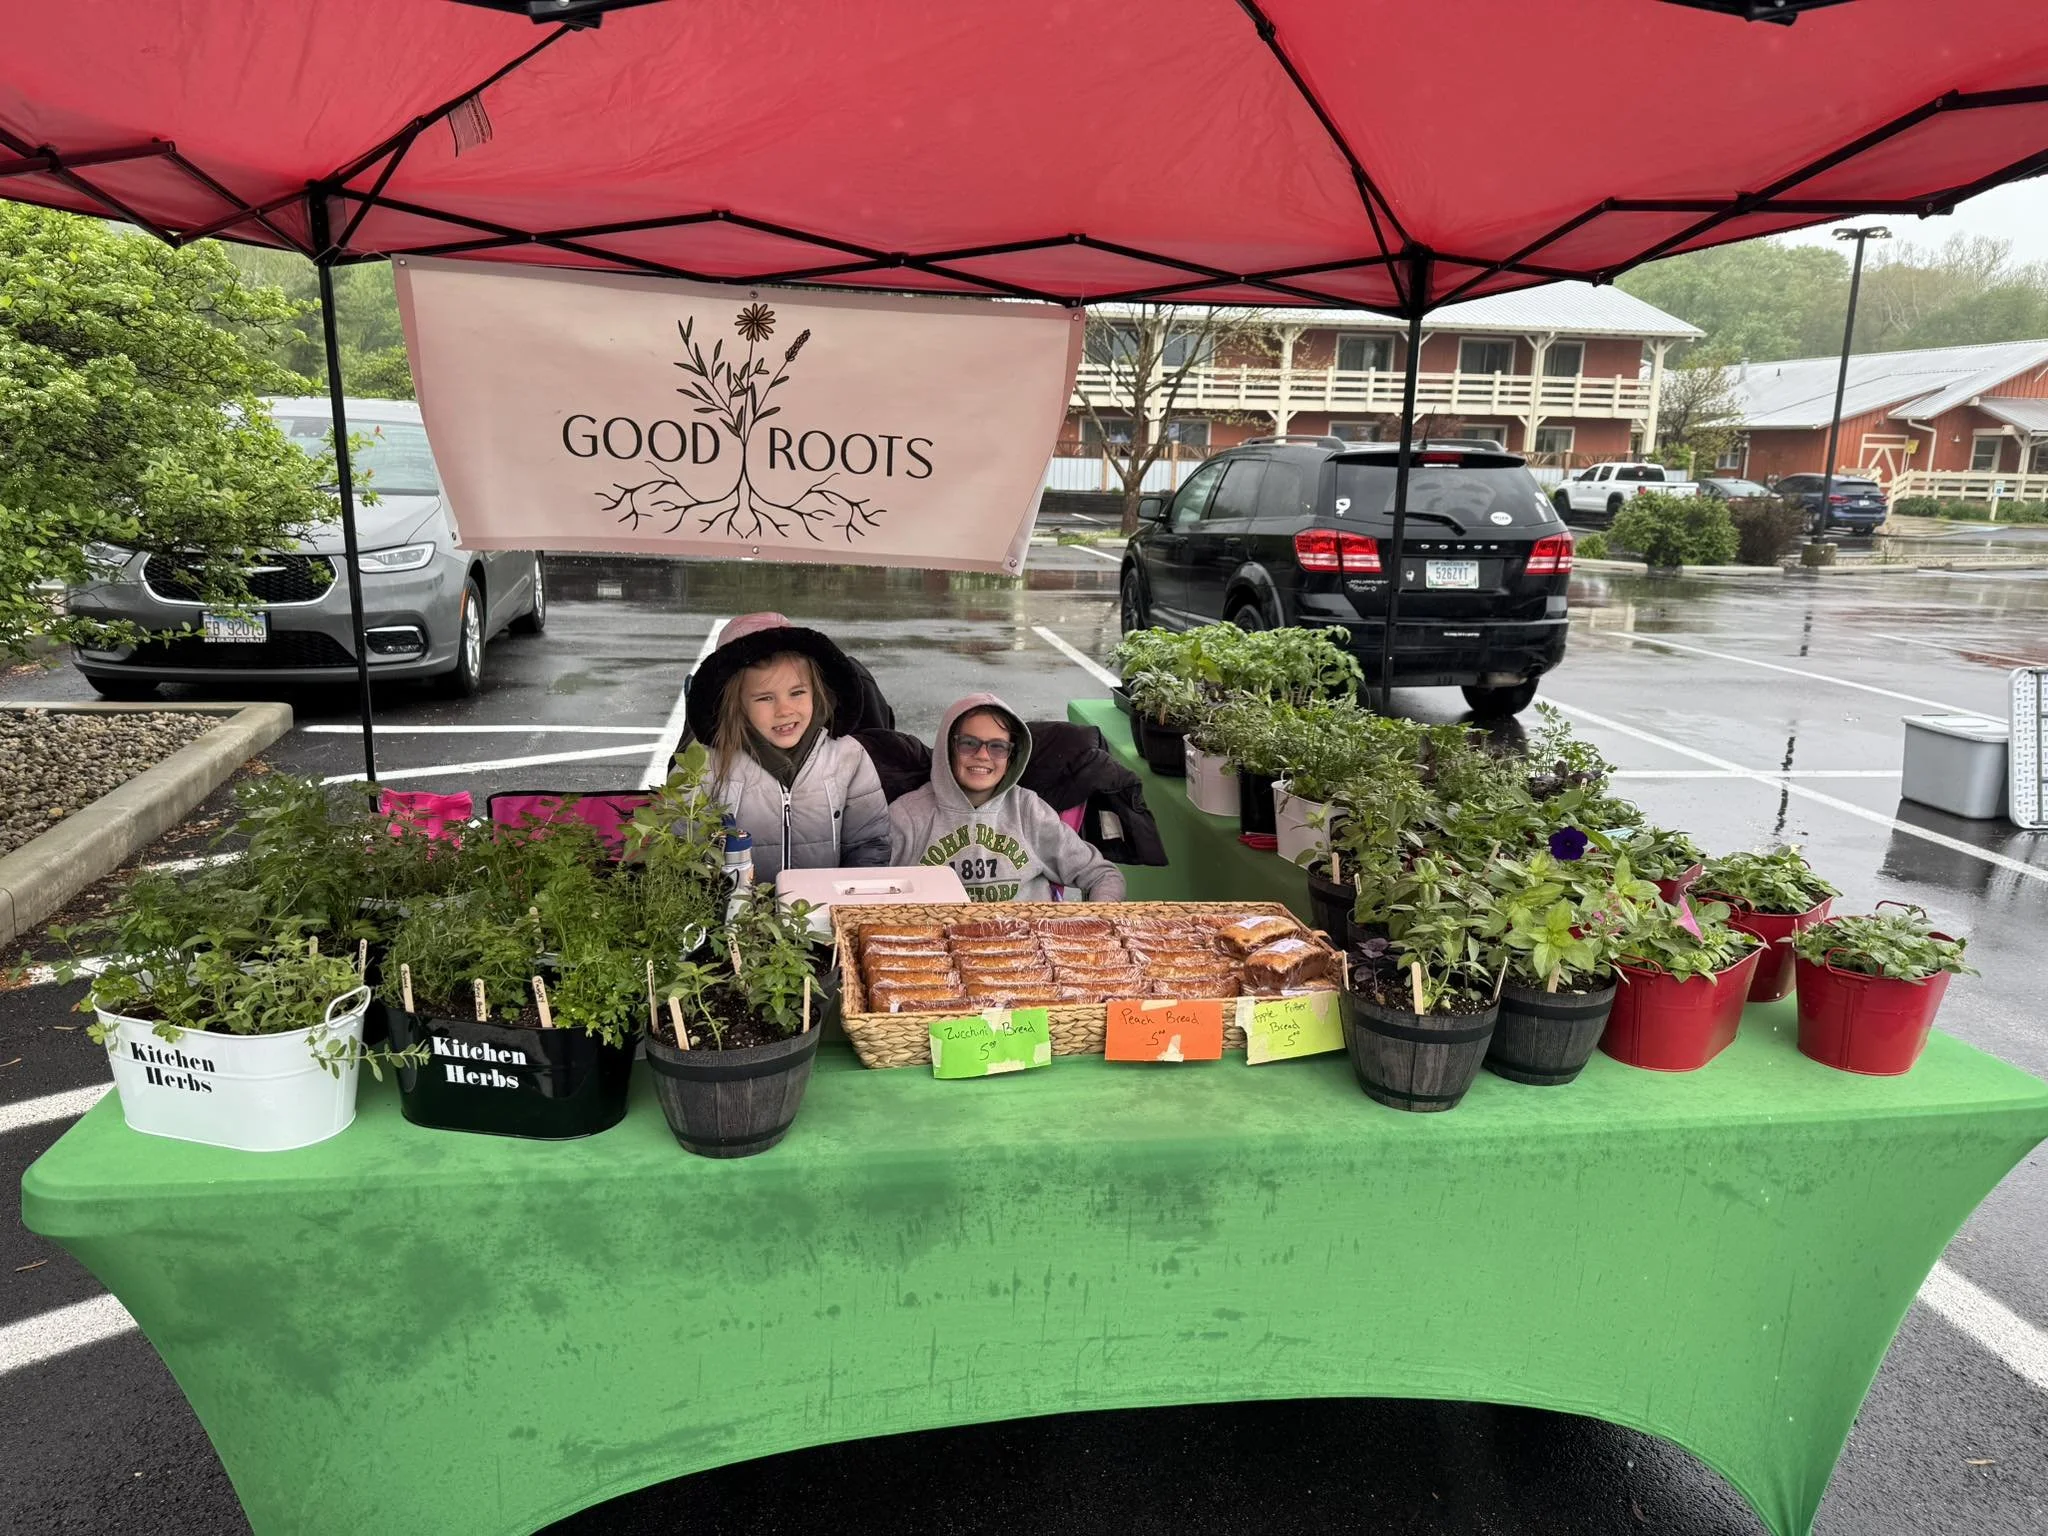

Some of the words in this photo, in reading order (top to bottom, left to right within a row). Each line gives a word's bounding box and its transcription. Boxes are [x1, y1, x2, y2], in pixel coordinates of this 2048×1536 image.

[562, 414, 720, 465] GOOD
[768, 427, 934, 480] ROOTS
[975, 823, 1030, 871] DEERE
[1121, 1007, 1155, 1025] Peach
[1165, 1010, 1200, 1025] Bread
[1269, 1018, 1301, 1034] Bread
[943, 1025, 989, 1041] Zucchini
[1001, 1021, 1036, 1038] Bread
[130, 1040, 216, 1073] Kitchen
[431, 1035, 528, 1066] Kitchen
[145, 1065, 213, 1094] Herbs
[443, 1063, 520, 1090] Herbs
